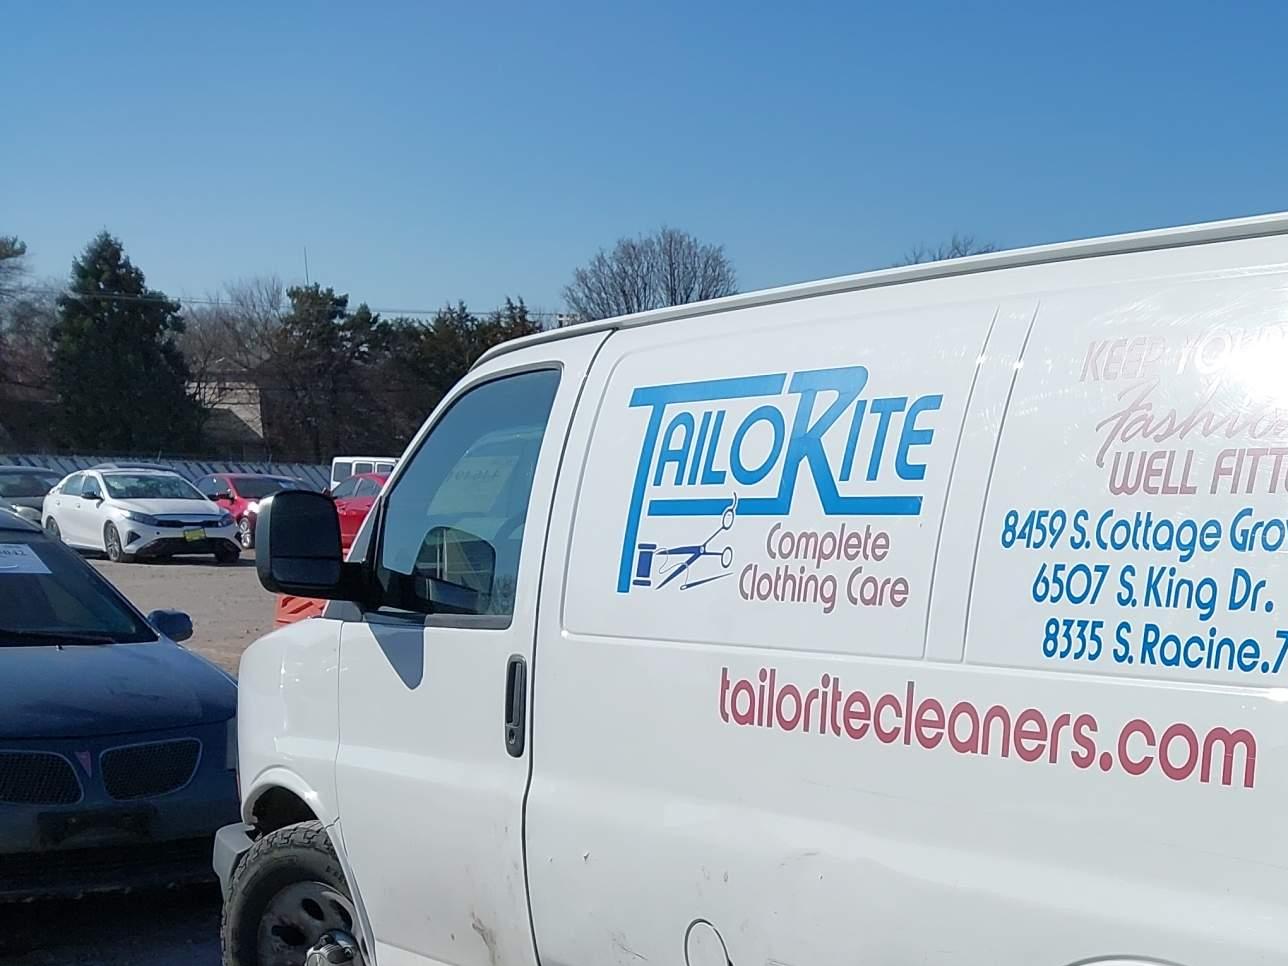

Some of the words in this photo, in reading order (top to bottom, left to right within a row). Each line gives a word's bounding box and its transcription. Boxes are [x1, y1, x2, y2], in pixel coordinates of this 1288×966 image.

[1079, 336, 1165, 383] KEEP
[1176, 322, 1285, 376] YO
[1108, 449, 1198, 496] WELL
[766, 522, 890, 569] Complete
[1001, 509, 1067, 550] 8459
[739, 563, 838, 614] Clothing
[847, 566, 909, 608] Care
[1032, 563, 1111, 605] 6507
[1228, 567, 1273, 613] Dr.
[1043, 617, 1104, 662] 8335
[719, 666, 1257, 788] tailoritecleaners.com
